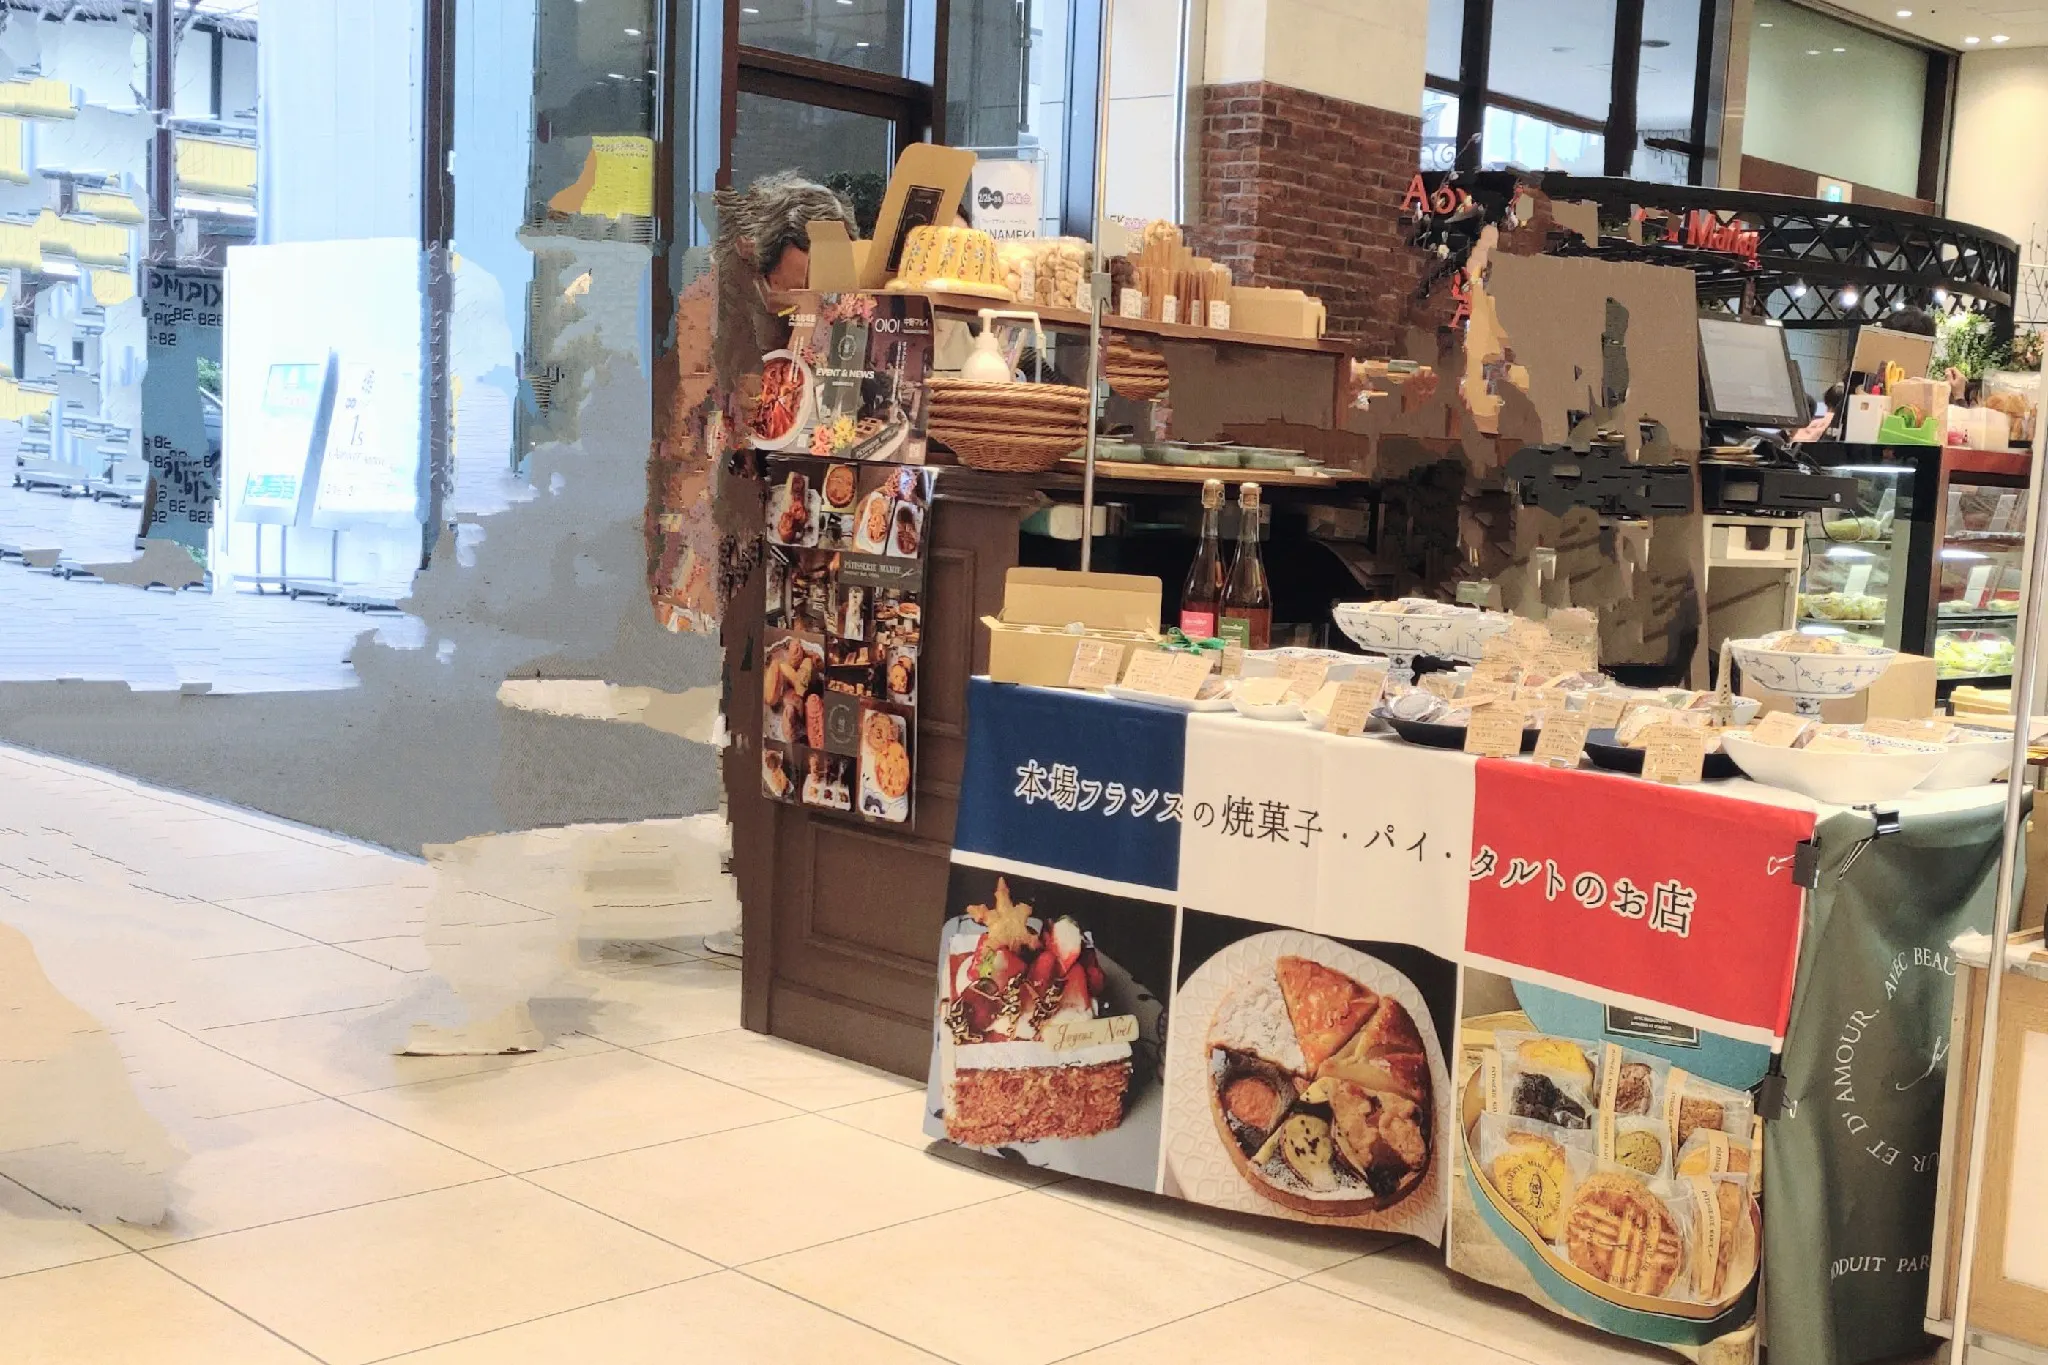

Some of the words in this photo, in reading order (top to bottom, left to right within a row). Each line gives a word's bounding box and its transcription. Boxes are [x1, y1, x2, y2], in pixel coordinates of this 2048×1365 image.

[816, 368, 841, 377] EVENT
[849, 369, 875, 379] NEWS
[1866, 1140, 1901, 1165] ET
[1896, 1255, 1930, 1273] PAR
